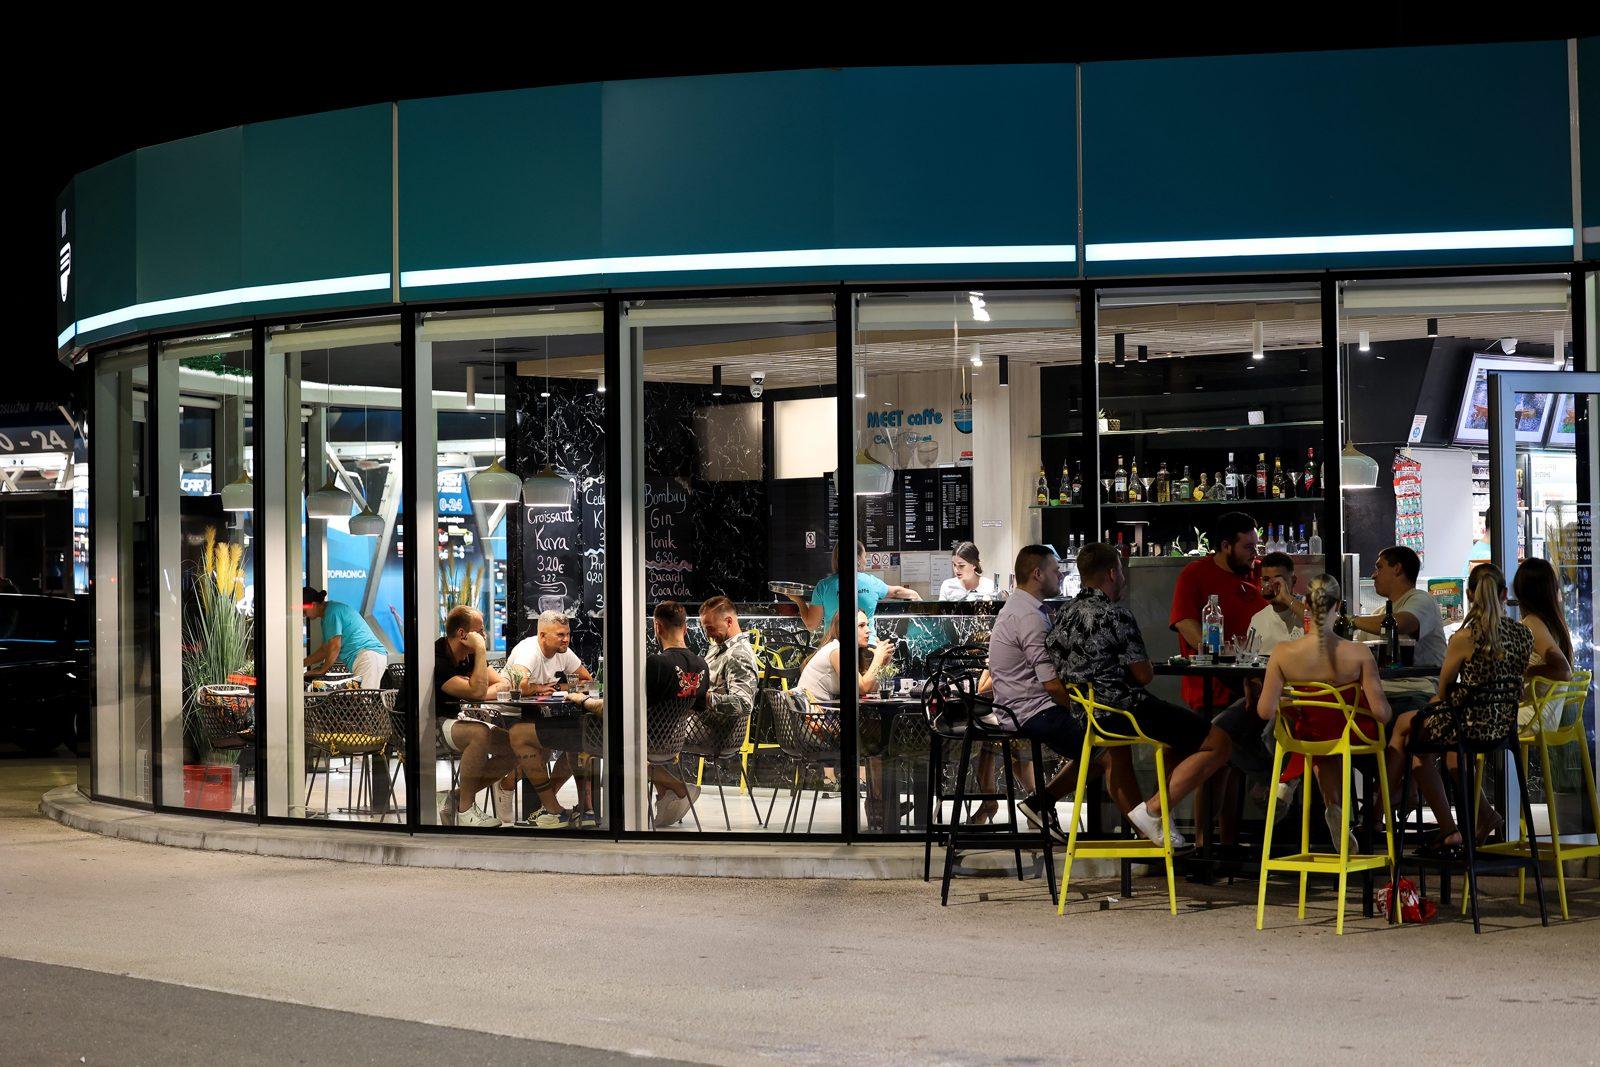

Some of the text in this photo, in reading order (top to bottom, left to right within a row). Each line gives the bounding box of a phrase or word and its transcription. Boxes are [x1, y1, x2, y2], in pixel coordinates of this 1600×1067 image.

[867, 408, 943, 428] MEET caffe
[31, 429, 68, 450] 24
[644, 483, 687, 514] Bombay
[527, 505, 574, 525] Croissant
[650, 508, 675, 529] Gin
[534, 525, 570, 551] Kava
[646, 529, 678, 549] Tonik
[648, 568, 684, 584] Bacardi
[650, 582, 693, 597] Coca Cola
